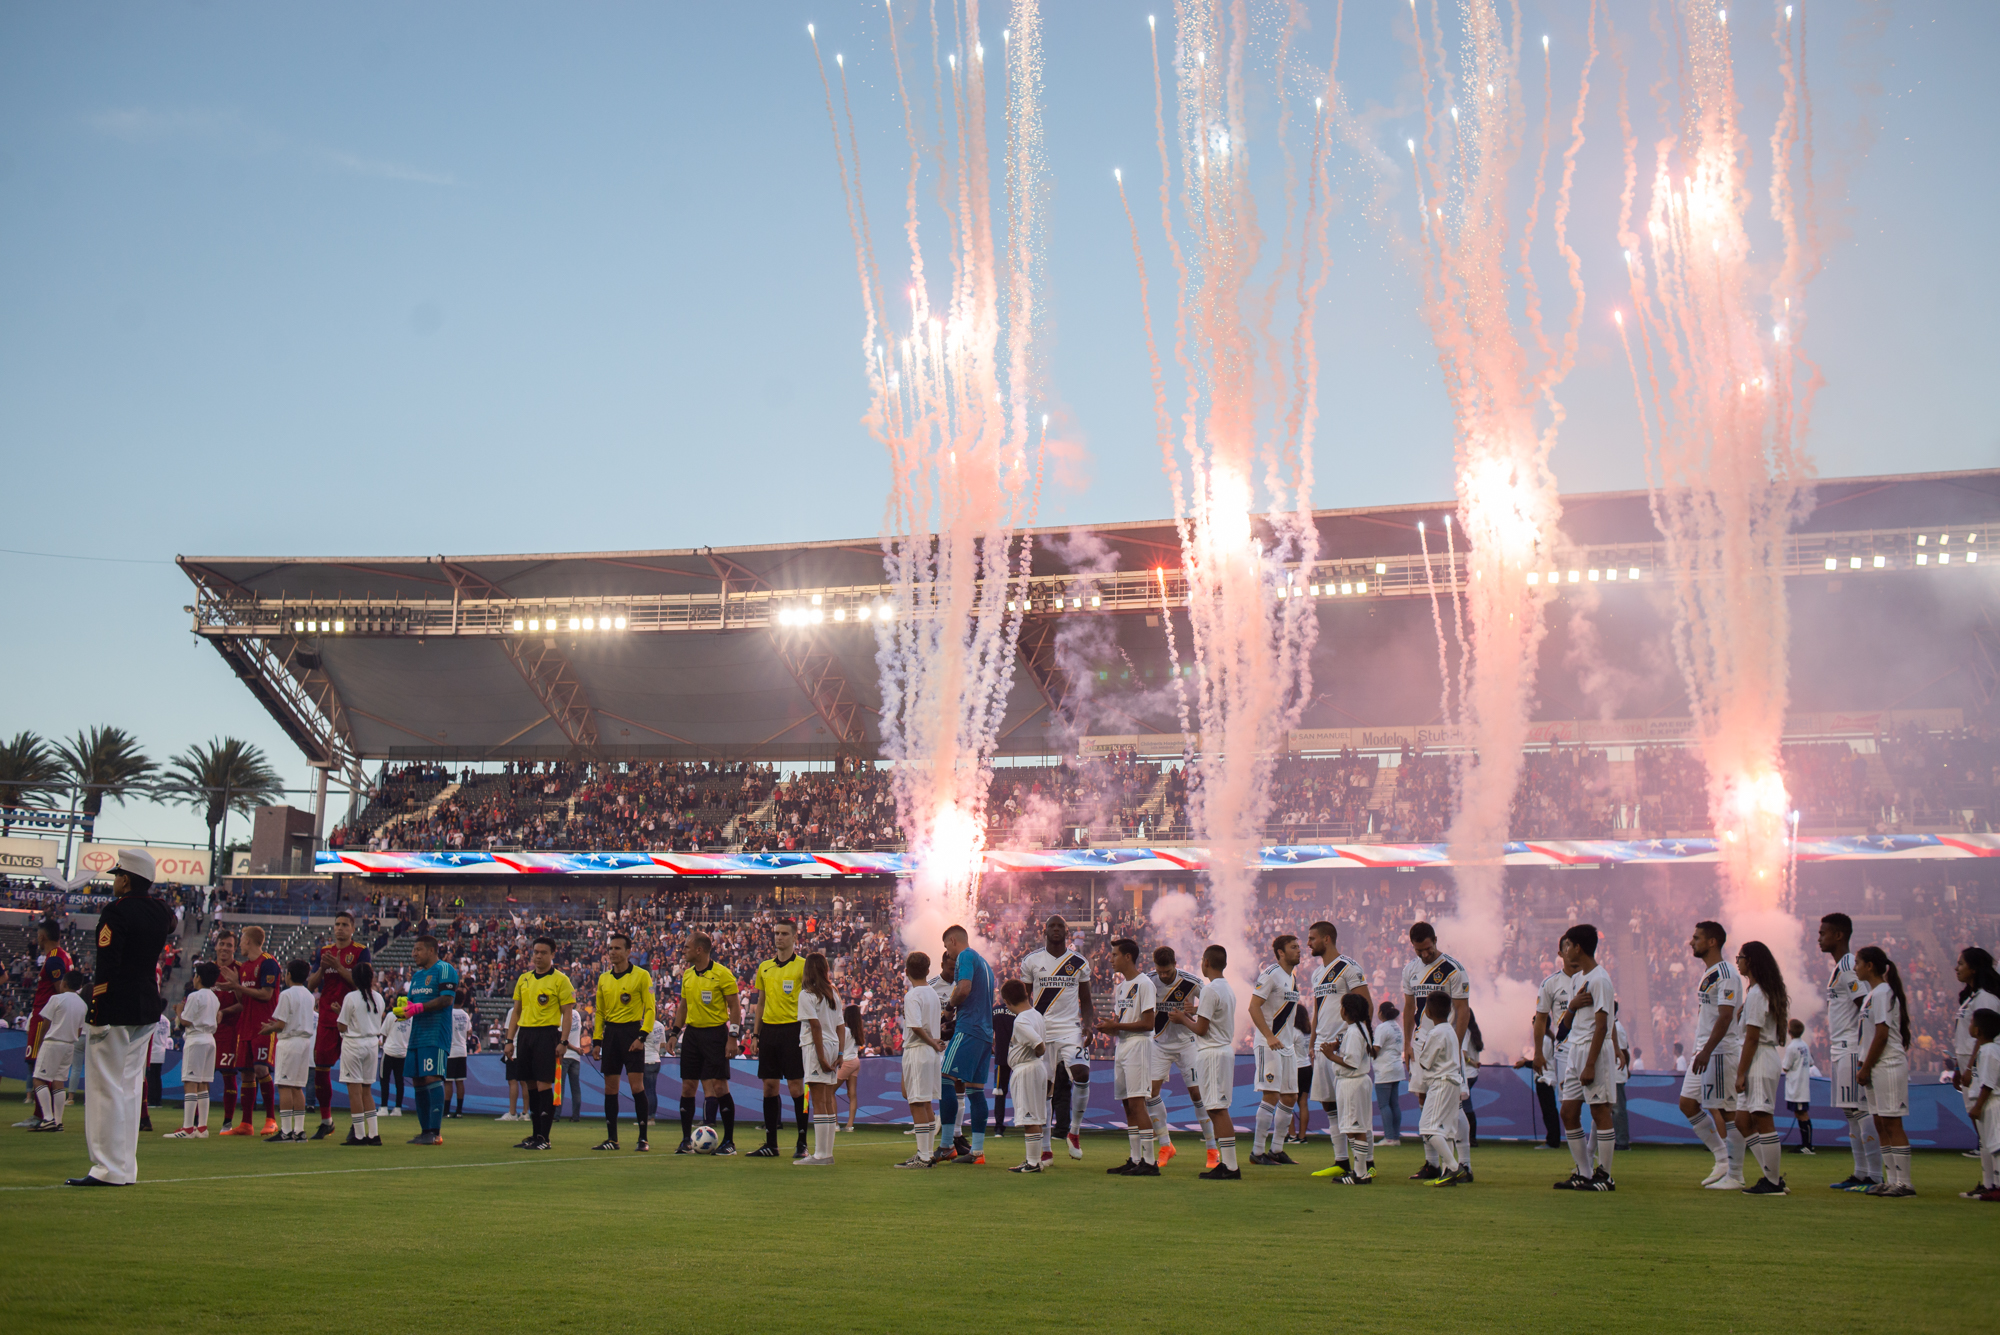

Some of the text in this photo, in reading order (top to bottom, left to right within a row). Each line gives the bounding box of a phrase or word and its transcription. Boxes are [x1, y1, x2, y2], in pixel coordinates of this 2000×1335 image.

[1650, 721, 1695, 729] AMERIC
[1316, 732, 1350, 740] MANUEL
[1363, 731, 1404, 746] Modelo
[1084, 744, 1137, 753] DRAFTKIGS
[156, 858, 204, 876] OTA
[15, 890, 64, 903] LA GALXY
[220, 1053, 235, 1066] 27
[258, 1047, 268, 1060] 15
[1075, 1046, 1090, 1061] 28
[423, 1058, 434, 1072] 18
[1703, 1084, 1714, 1100] 17
[1841, 1086, 1850, 1102] 11
